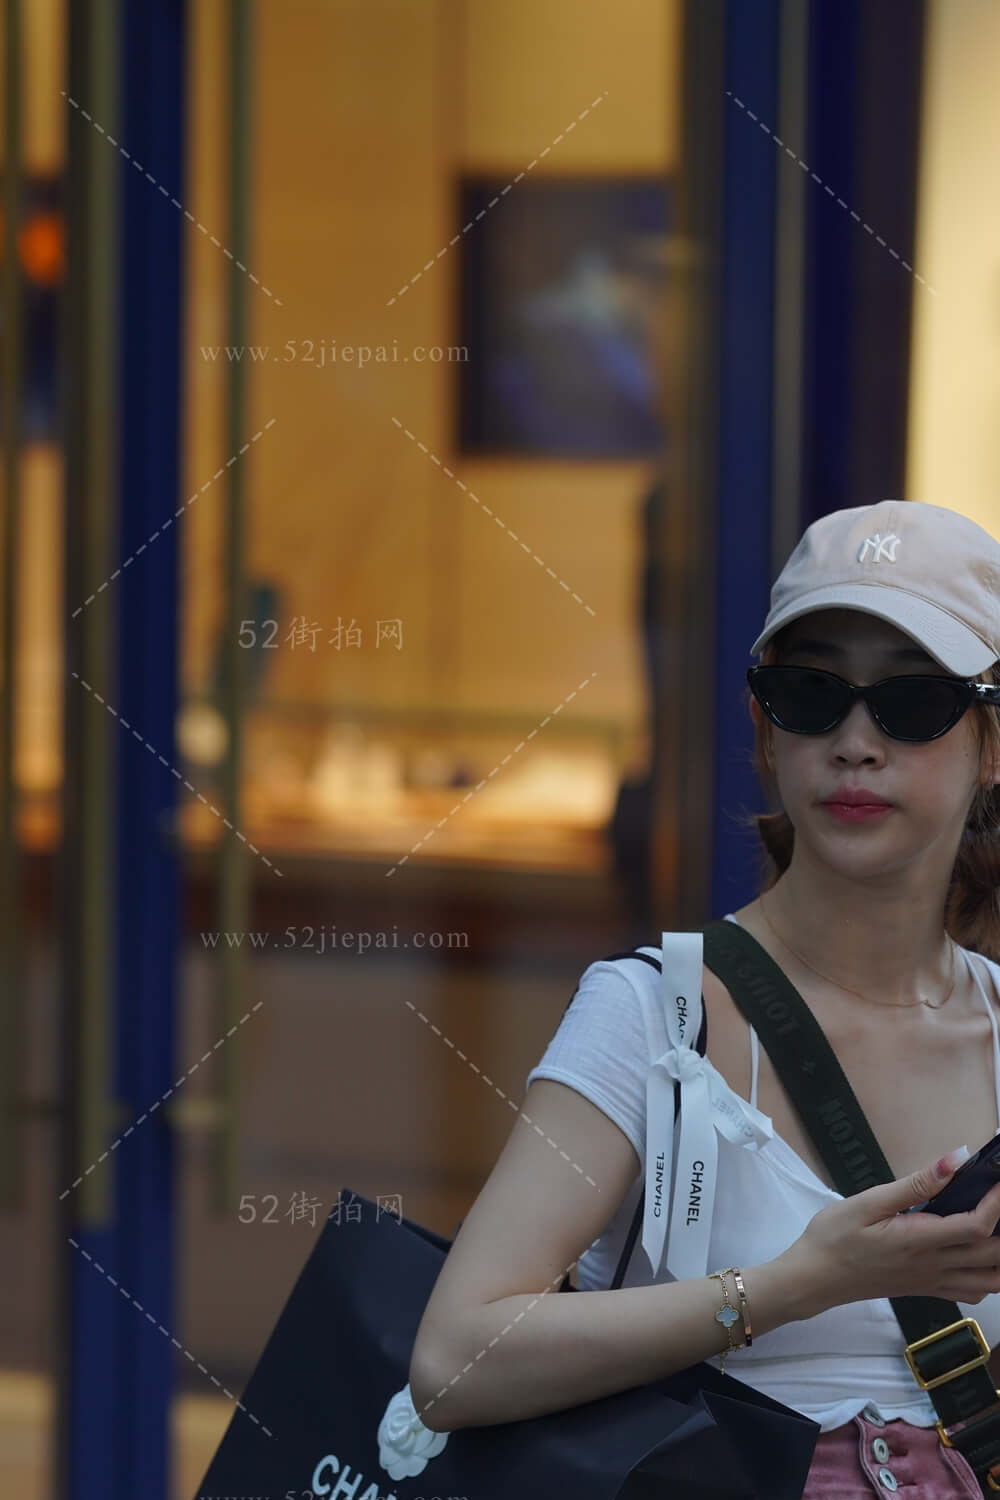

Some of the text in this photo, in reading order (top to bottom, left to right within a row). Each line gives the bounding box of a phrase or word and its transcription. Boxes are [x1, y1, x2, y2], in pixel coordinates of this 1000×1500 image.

[676, 996, 688, 1040] CHA
[653, 1151, 665, 1219] CHANEL
[686, 1160, 705, 1226] CHANEL
